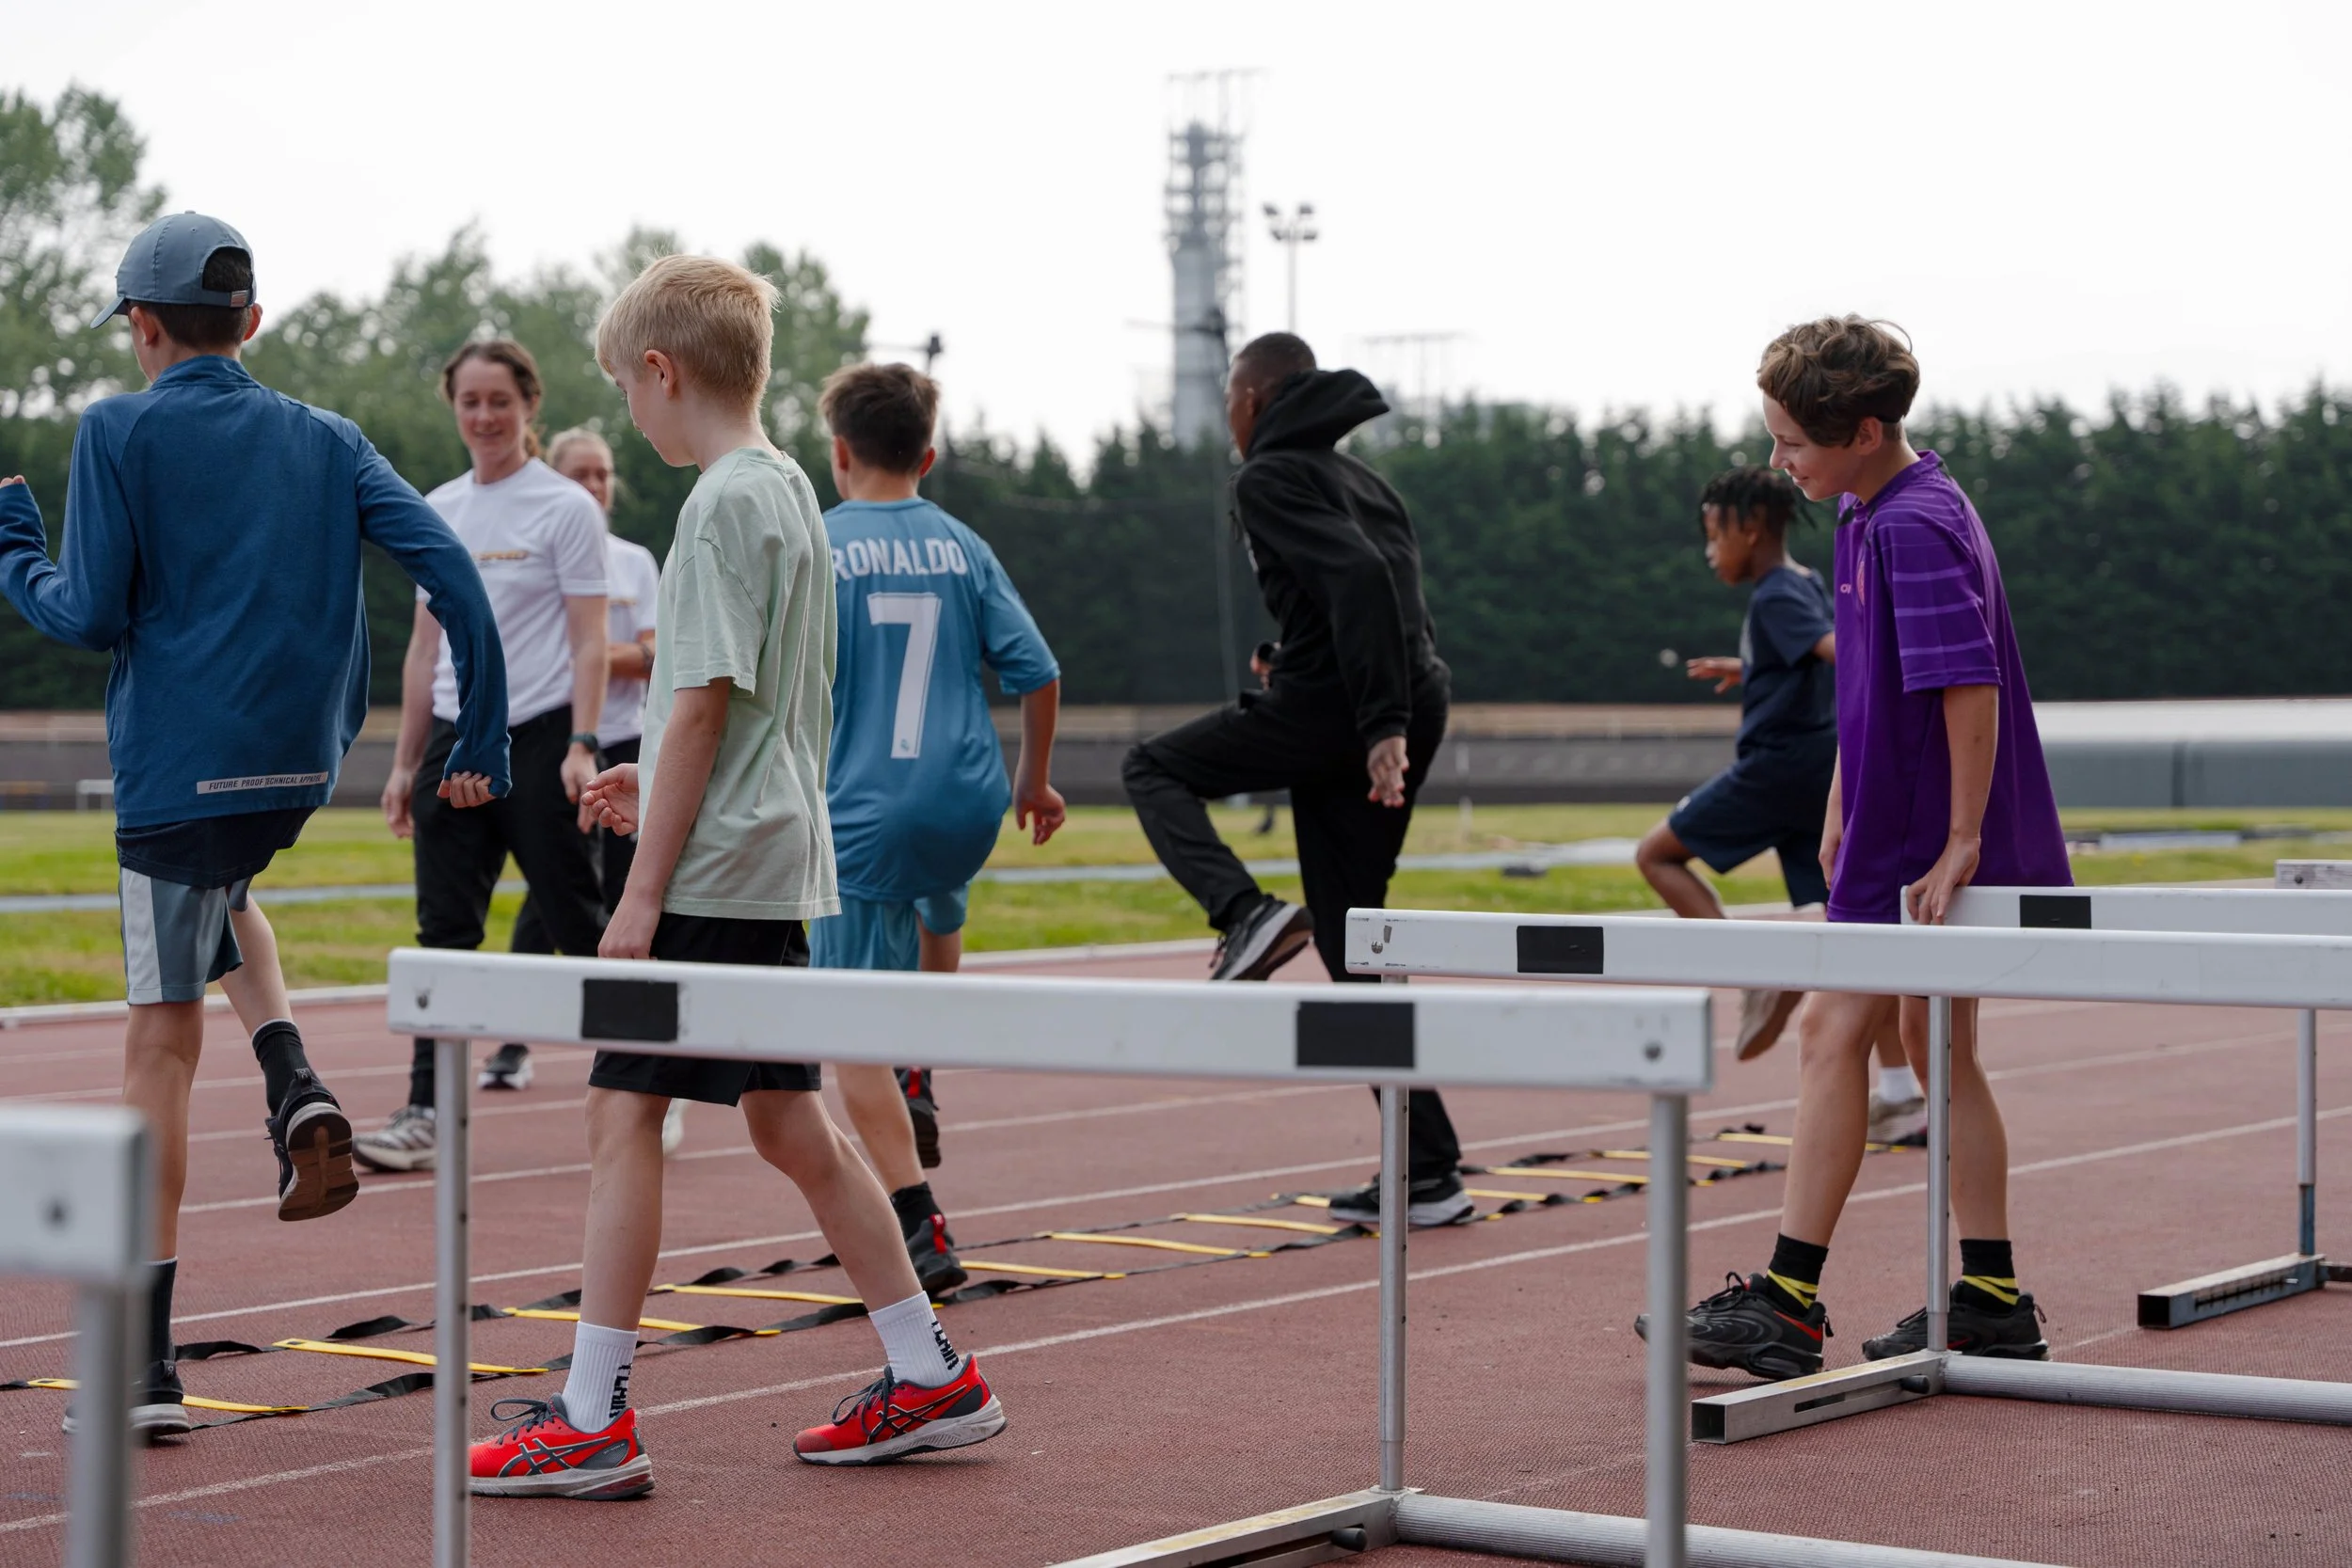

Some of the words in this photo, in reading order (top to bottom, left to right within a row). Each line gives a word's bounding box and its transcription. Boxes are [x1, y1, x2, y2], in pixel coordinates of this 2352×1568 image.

[832, 537, 969, 581] RONALDO
[866, 592, 942, 759] 7
[209, 780, 238, 791] FUTURE
[241, 778, 263, 787] PROOF
[264, 776, 297, 785] TECHNICAL
